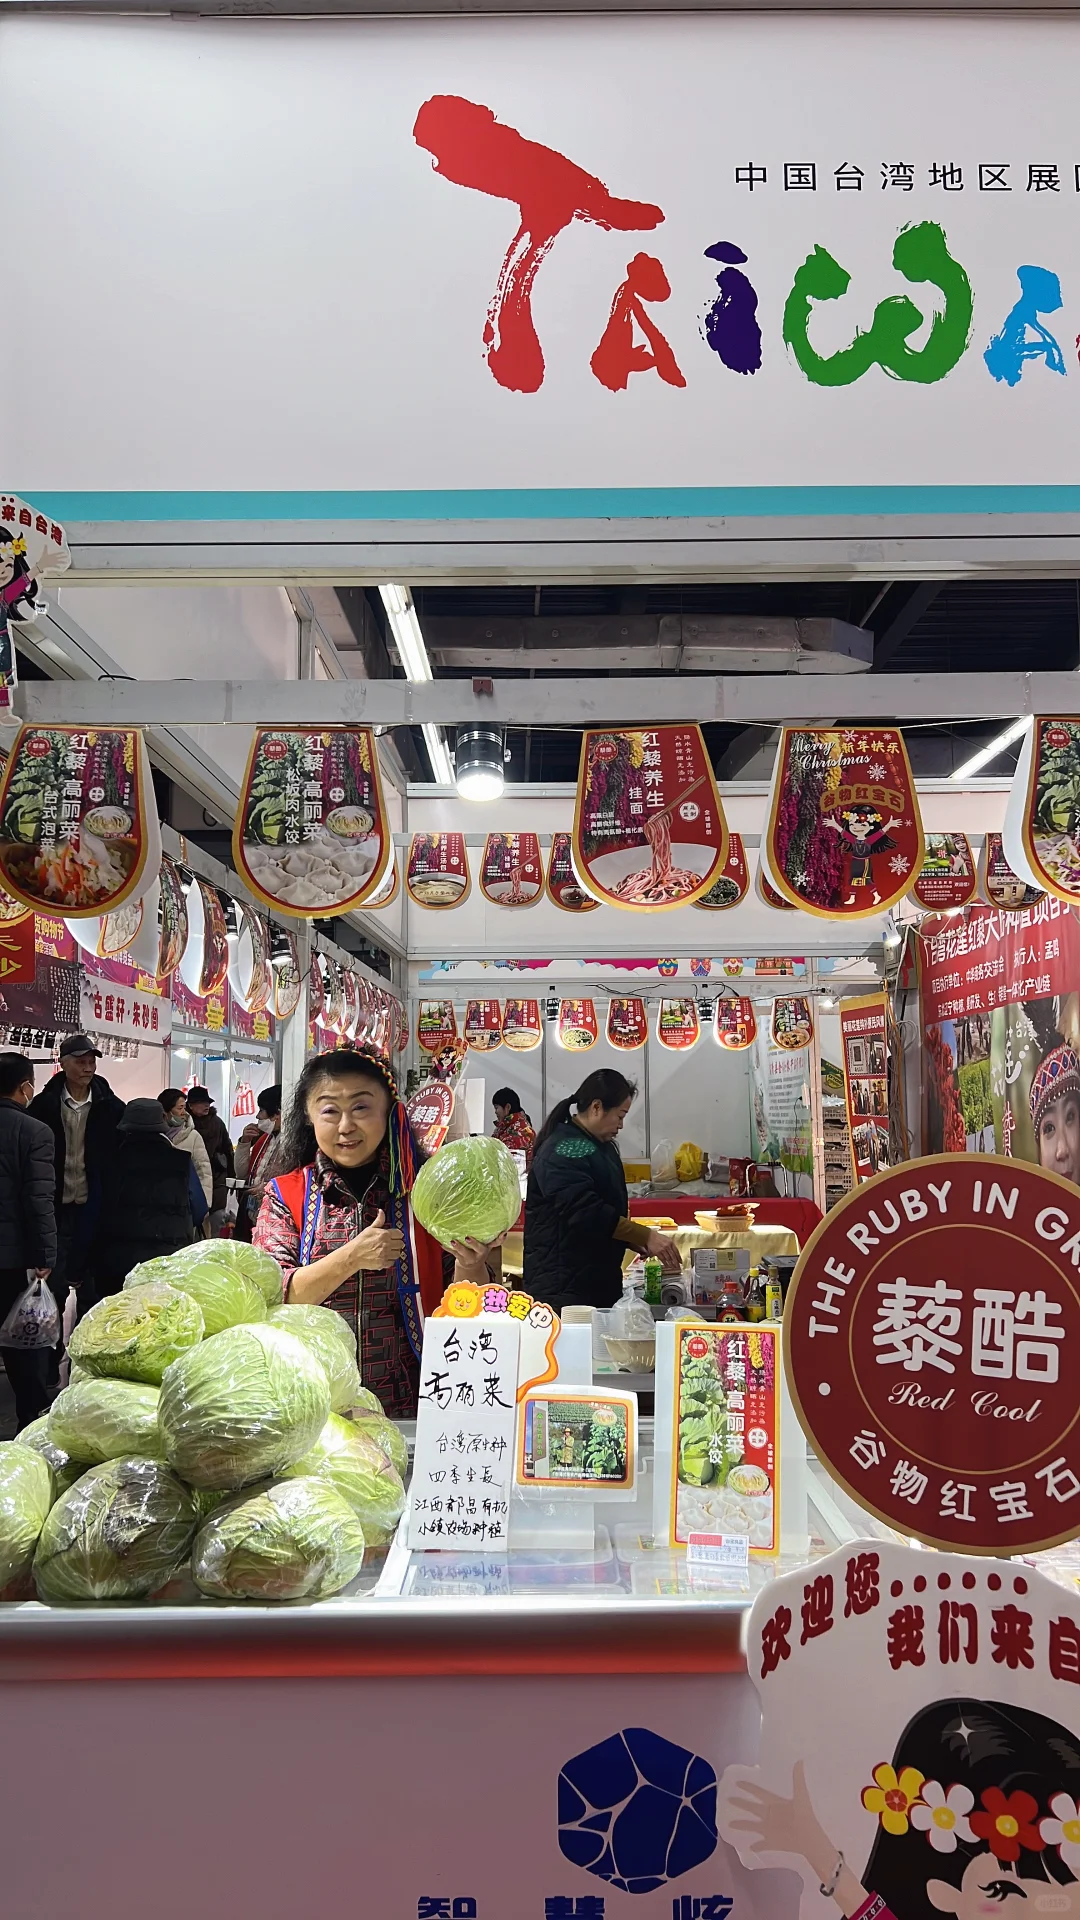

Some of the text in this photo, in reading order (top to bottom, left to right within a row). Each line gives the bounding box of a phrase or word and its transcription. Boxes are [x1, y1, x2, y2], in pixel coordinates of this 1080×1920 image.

[735, 162, 1080, 193] 中国台湾地区展
[790, 739, 837, 757] Merry
[800, 750, 872, 769] Christmas
[841, 739, 900, 754] 新年快乐
[302, 735, 325, 841] 红藜·高丽菜
[641, 732, 665, 808] 红藜养生
[628, 786, 643, 815] 挂面
[822, 786, 902, 810] 谷物红宝石
[40, 790, 60, 853] 台式泡菜
[808, 1256, 856, 1338] THE
[846, 1180, 953, 1256] RUBY
[972, 1180, 1020, 1220] IN
[484, 1287, 553, 1328] 热卖中
[443, 1327, 498, 1365] 台湾
[872, 1276, 1066, 1383] 藜酷
[419, 1372, 513, 1410] 高丽菜
[725, 1339, 746, 1455] 红藜·高丽菜
[888, 1381, 1043, 1423] Red Cool
[708, 1432, 724, 1465] 水饺
[849, 1429, 1080, 1523] 谷物红宝石
[887, 1600, 1080, 1684] 我们来自
